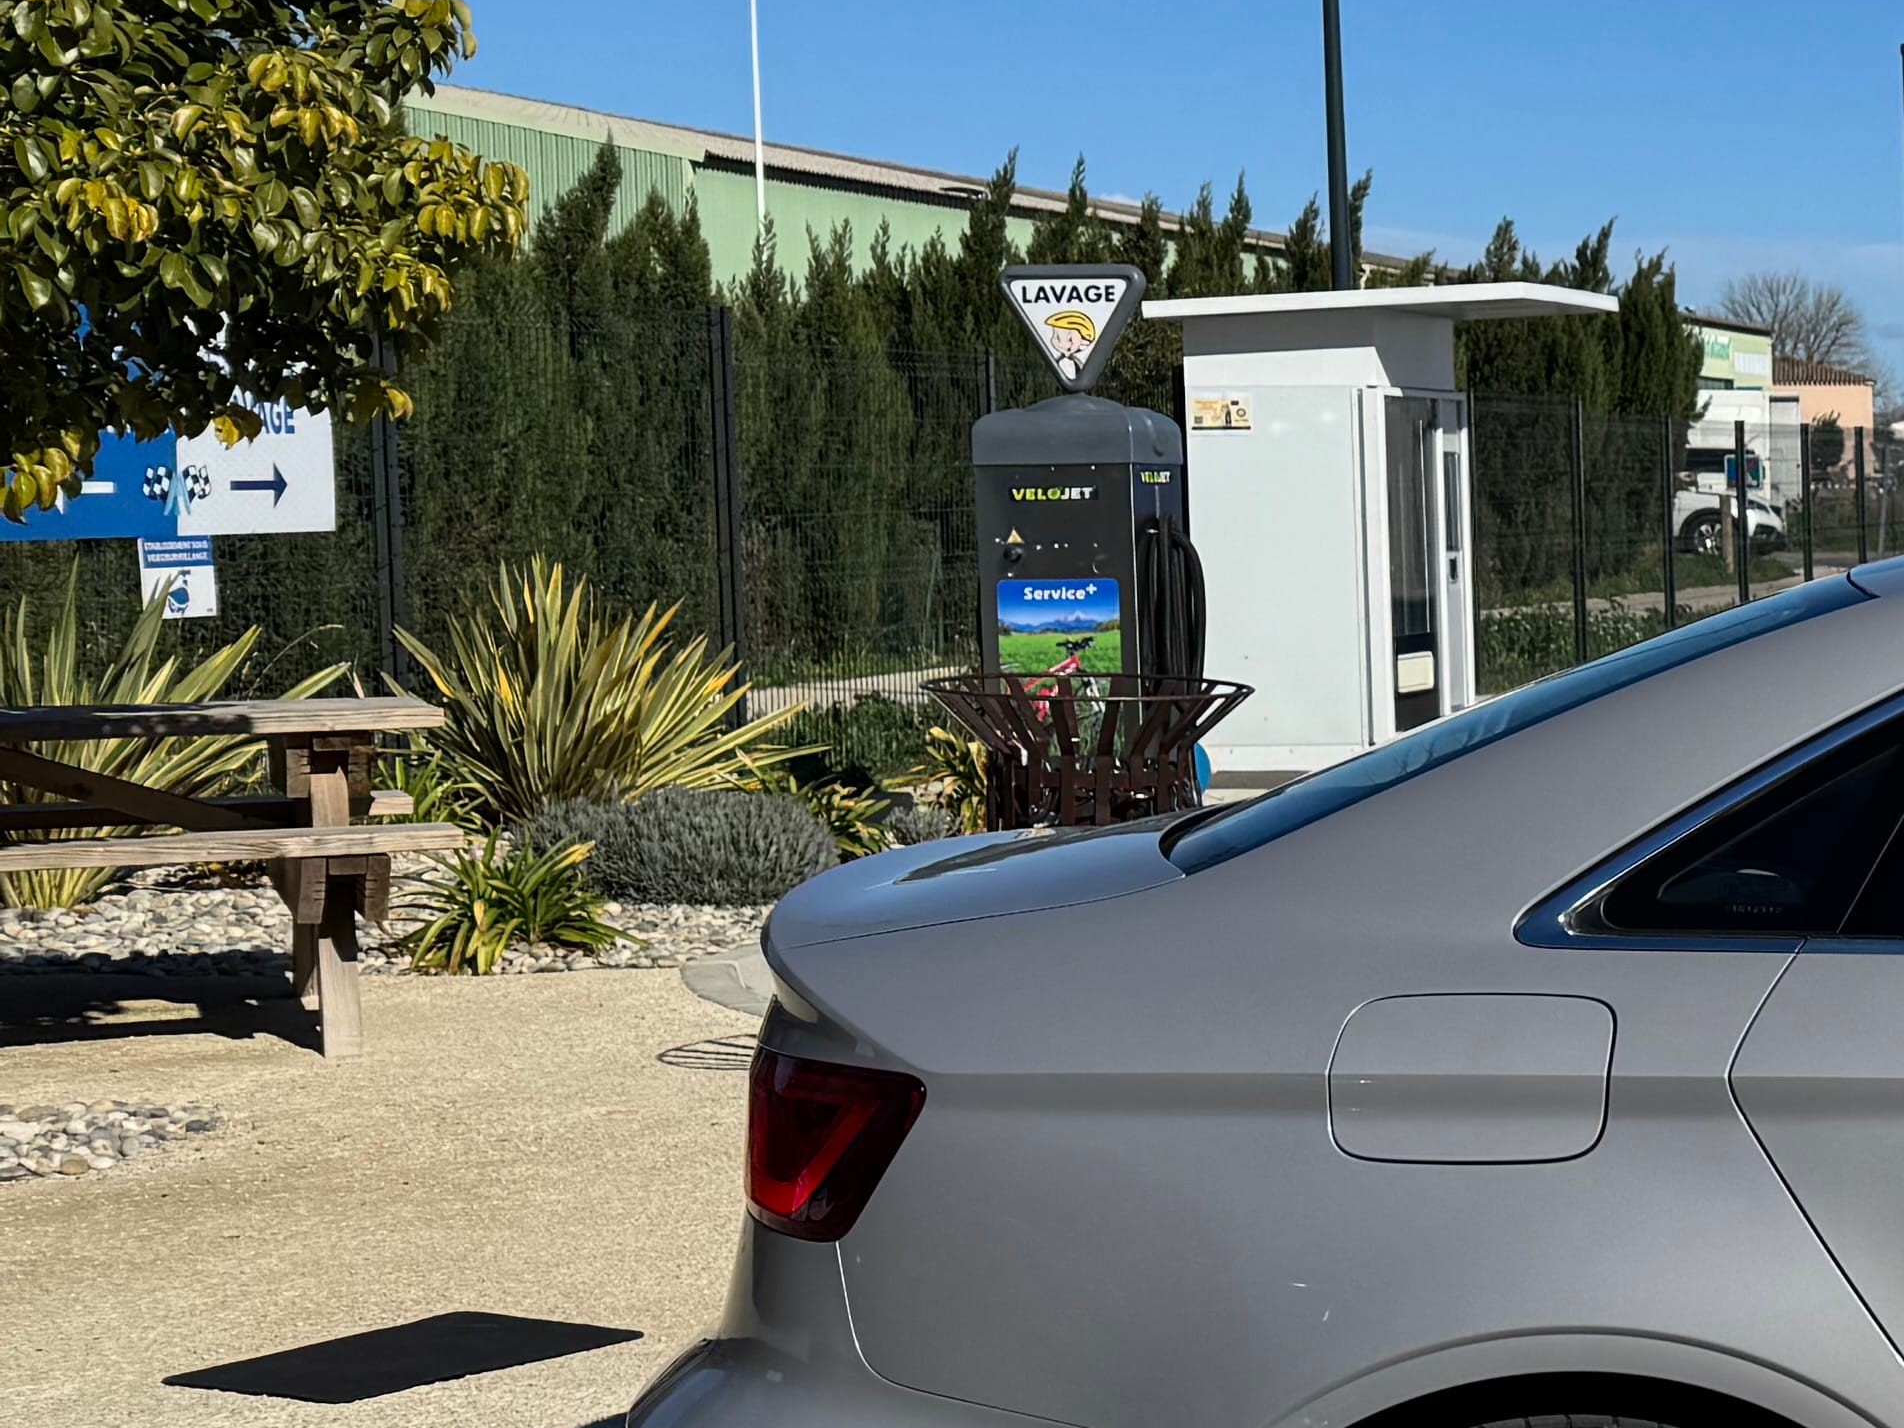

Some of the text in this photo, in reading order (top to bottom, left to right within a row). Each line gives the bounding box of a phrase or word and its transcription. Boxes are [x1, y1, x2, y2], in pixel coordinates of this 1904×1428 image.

[1021, 284, 1116, 304] LAVAGE
[1011, 486, 1095, 501] VELOJET
[1023, 583, 1098, 600] Service+
